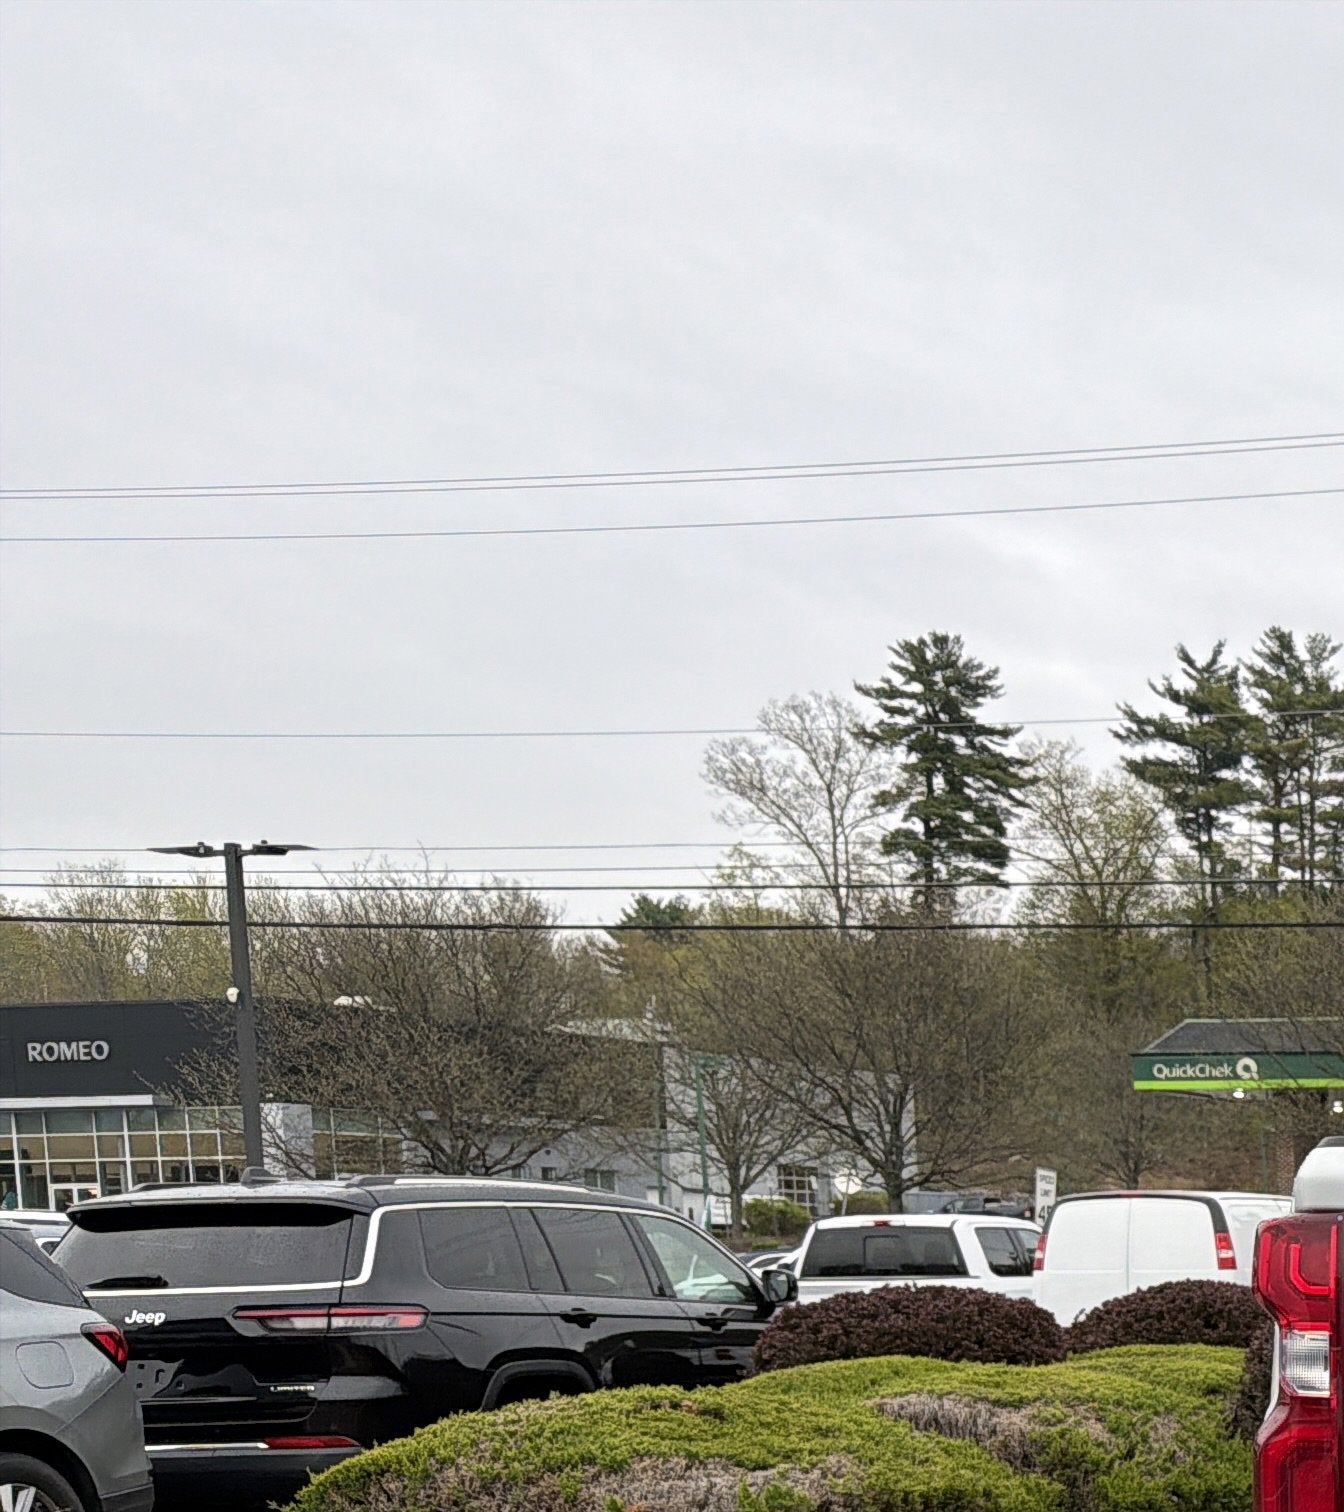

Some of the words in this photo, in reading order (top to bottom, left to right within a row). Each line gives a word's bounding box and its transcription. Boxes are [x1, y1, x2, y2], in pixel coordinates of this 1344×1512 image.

[26, 1040, 110, 1062] ROMEO
[1152, 1063, 1234, 1080] QuickChek
[124, 1309, 166, 1326] Jeep
